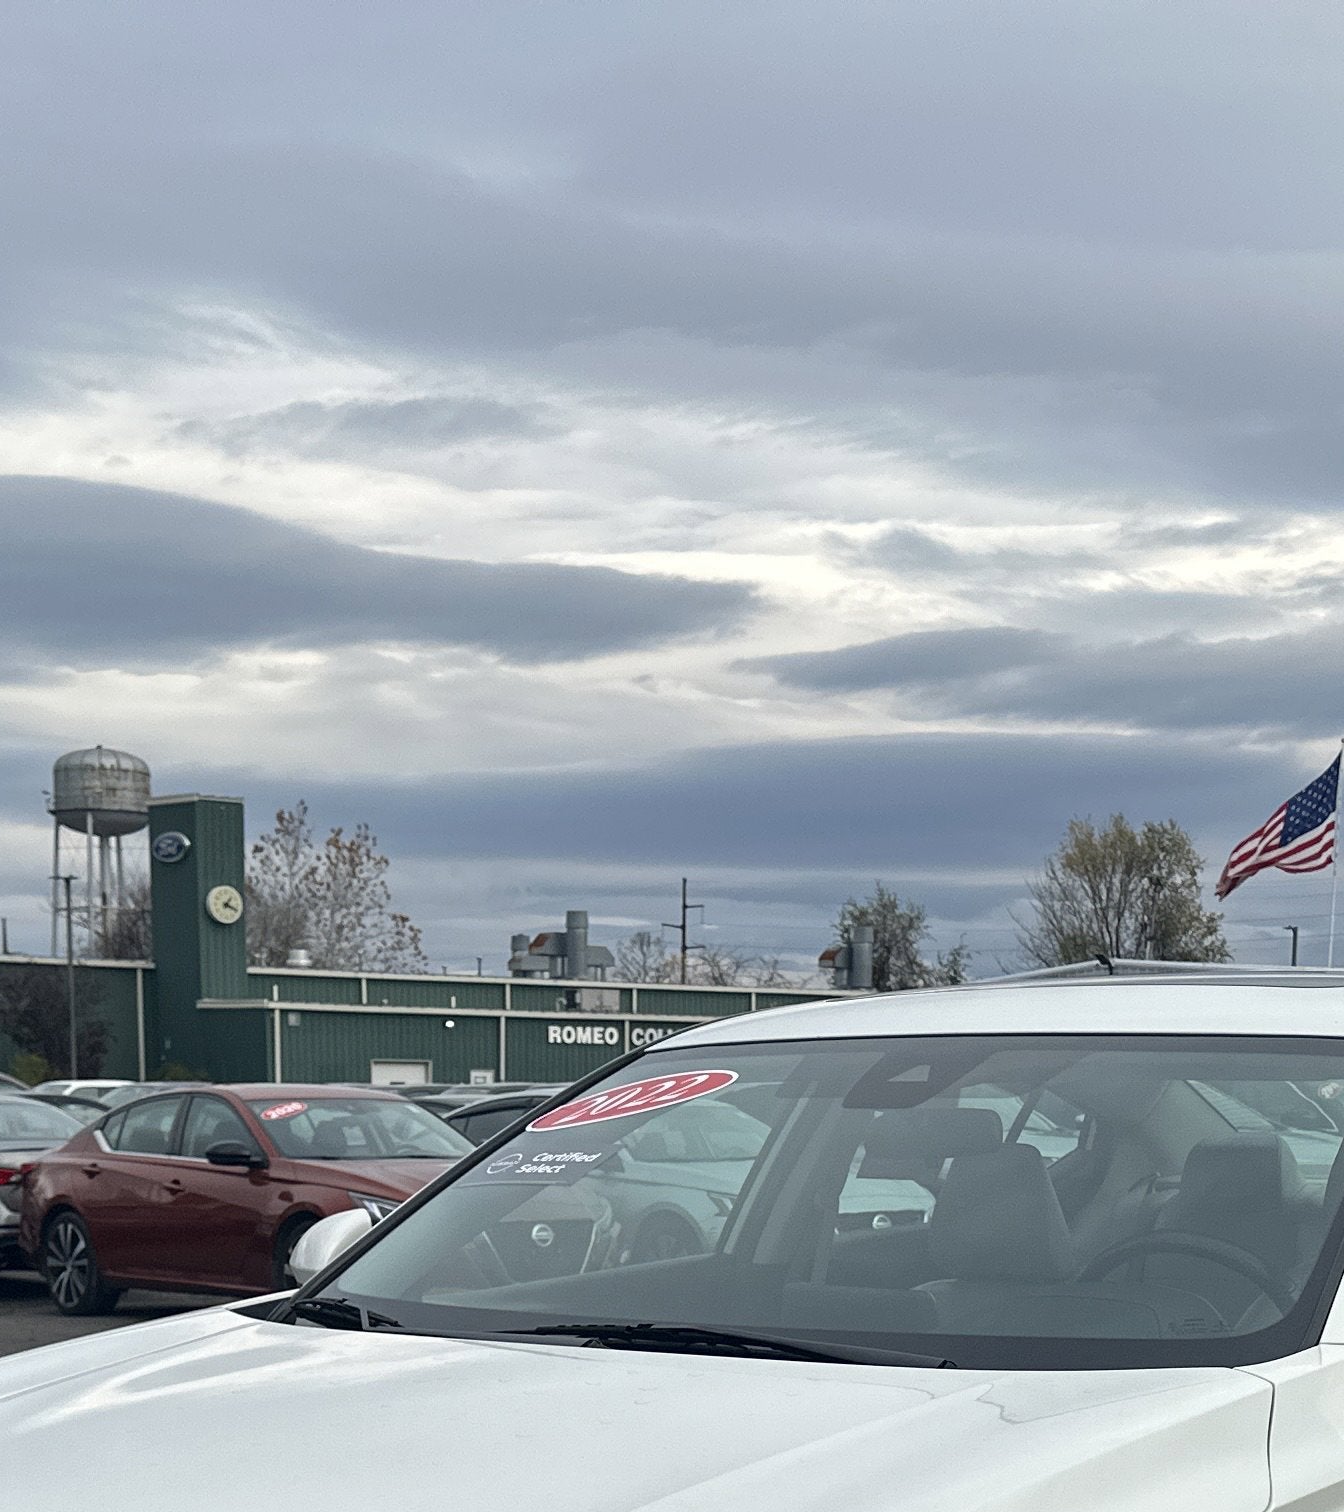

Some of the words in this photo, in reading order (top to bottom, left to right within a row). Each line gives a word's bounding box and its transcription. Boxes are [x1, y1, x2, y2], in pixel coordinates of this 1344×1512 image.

[548, 1026, 619, 1045] ROMEO
[631, 1028, 674, 1046] CO
[551, 1074, 710, 1126] 2022
[532, 1152, 602, 1162] Certified
[515, 1164, 566, 1173] Select
